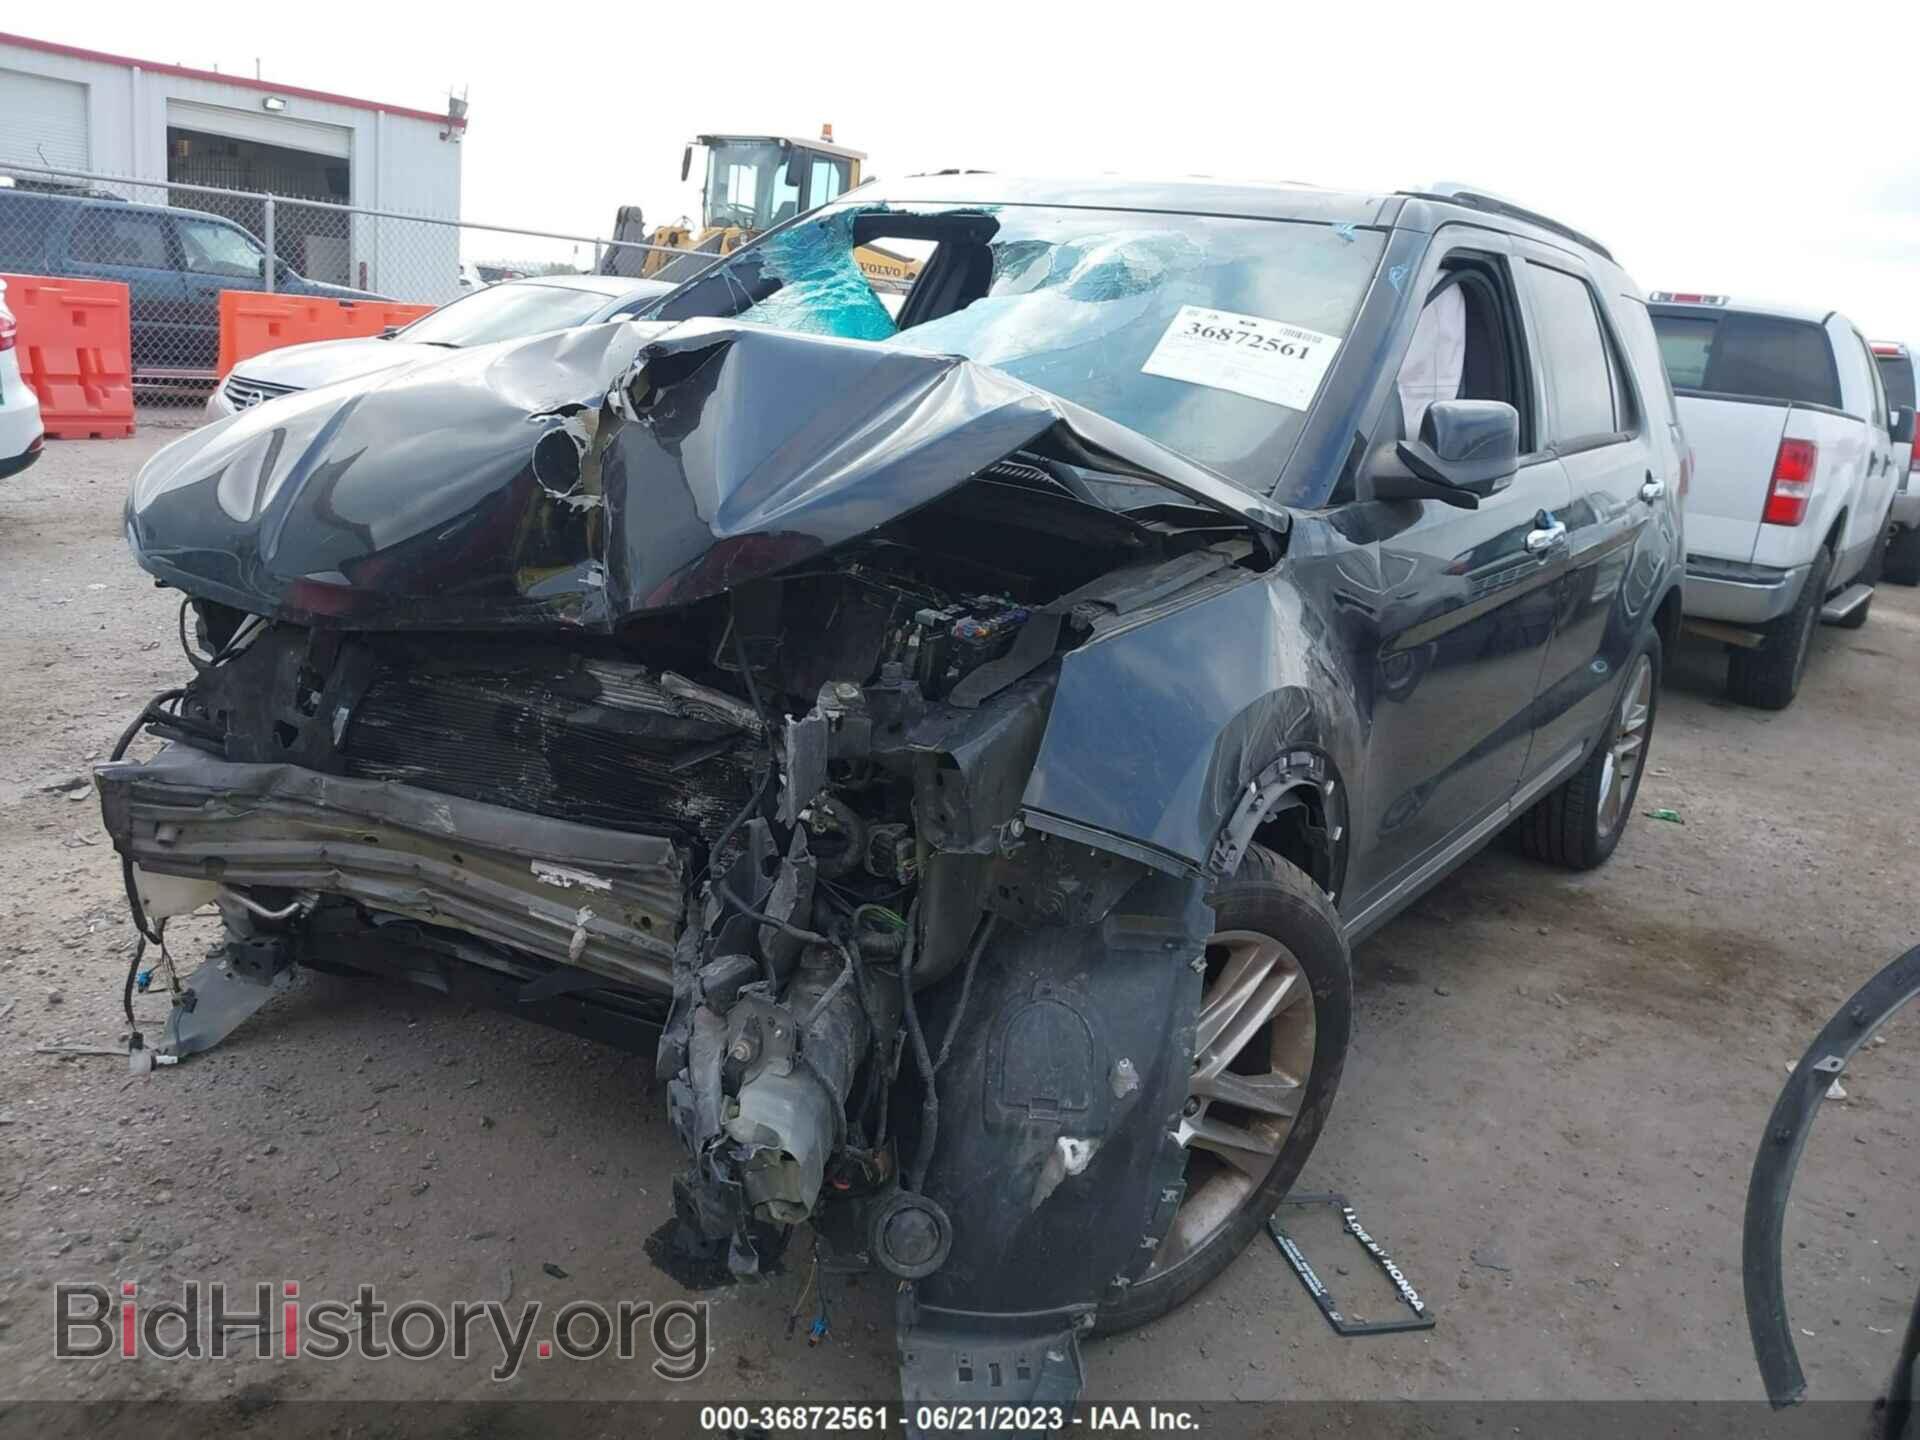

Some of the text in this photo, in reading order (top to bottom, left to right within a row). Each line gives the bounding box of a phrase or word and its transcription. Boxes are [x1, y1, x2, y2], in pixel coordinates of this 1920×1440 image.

[860, 261, 901, 277] VOLVO
[1184, 322, 1309, 360] 36872561
[1346, 1215, 1373, 1242] LOVE
[1382, 1259, 1424, 1311] HONDA
